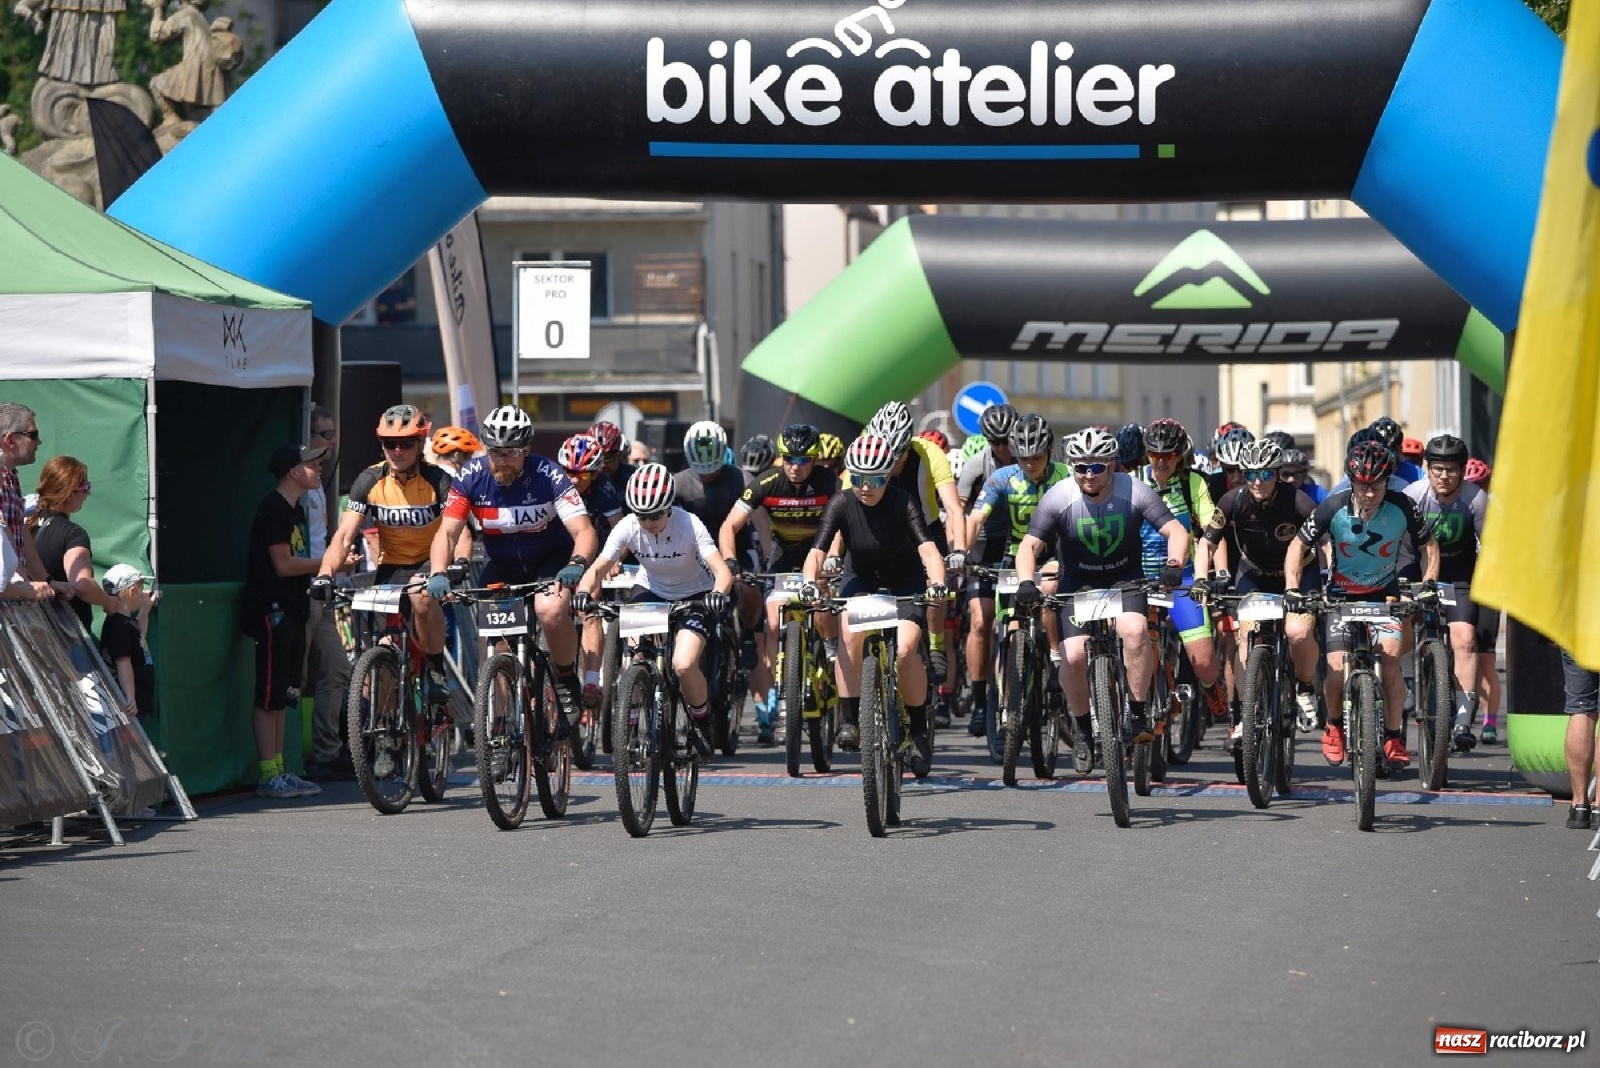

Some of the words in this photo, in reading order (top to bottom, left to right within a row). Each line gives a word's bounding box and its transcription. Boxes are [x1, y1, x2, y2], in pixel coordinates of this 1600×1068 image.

[646, 37, 843, 126] bike
[873, 39, 1176, 127] atelier
[534, 275, 575, 285] SEKTOR
[545, 290, 567, 300] PRO
[545, 320, 564, 350] 0
[1011, 319, 1400, 354] MERIDA
[456, 459, 483, 482] IAM
[536, 459, 563, 485] IAM
[514, 507, 549, 526] IAM
[486, 612, 516, 625] 1324
